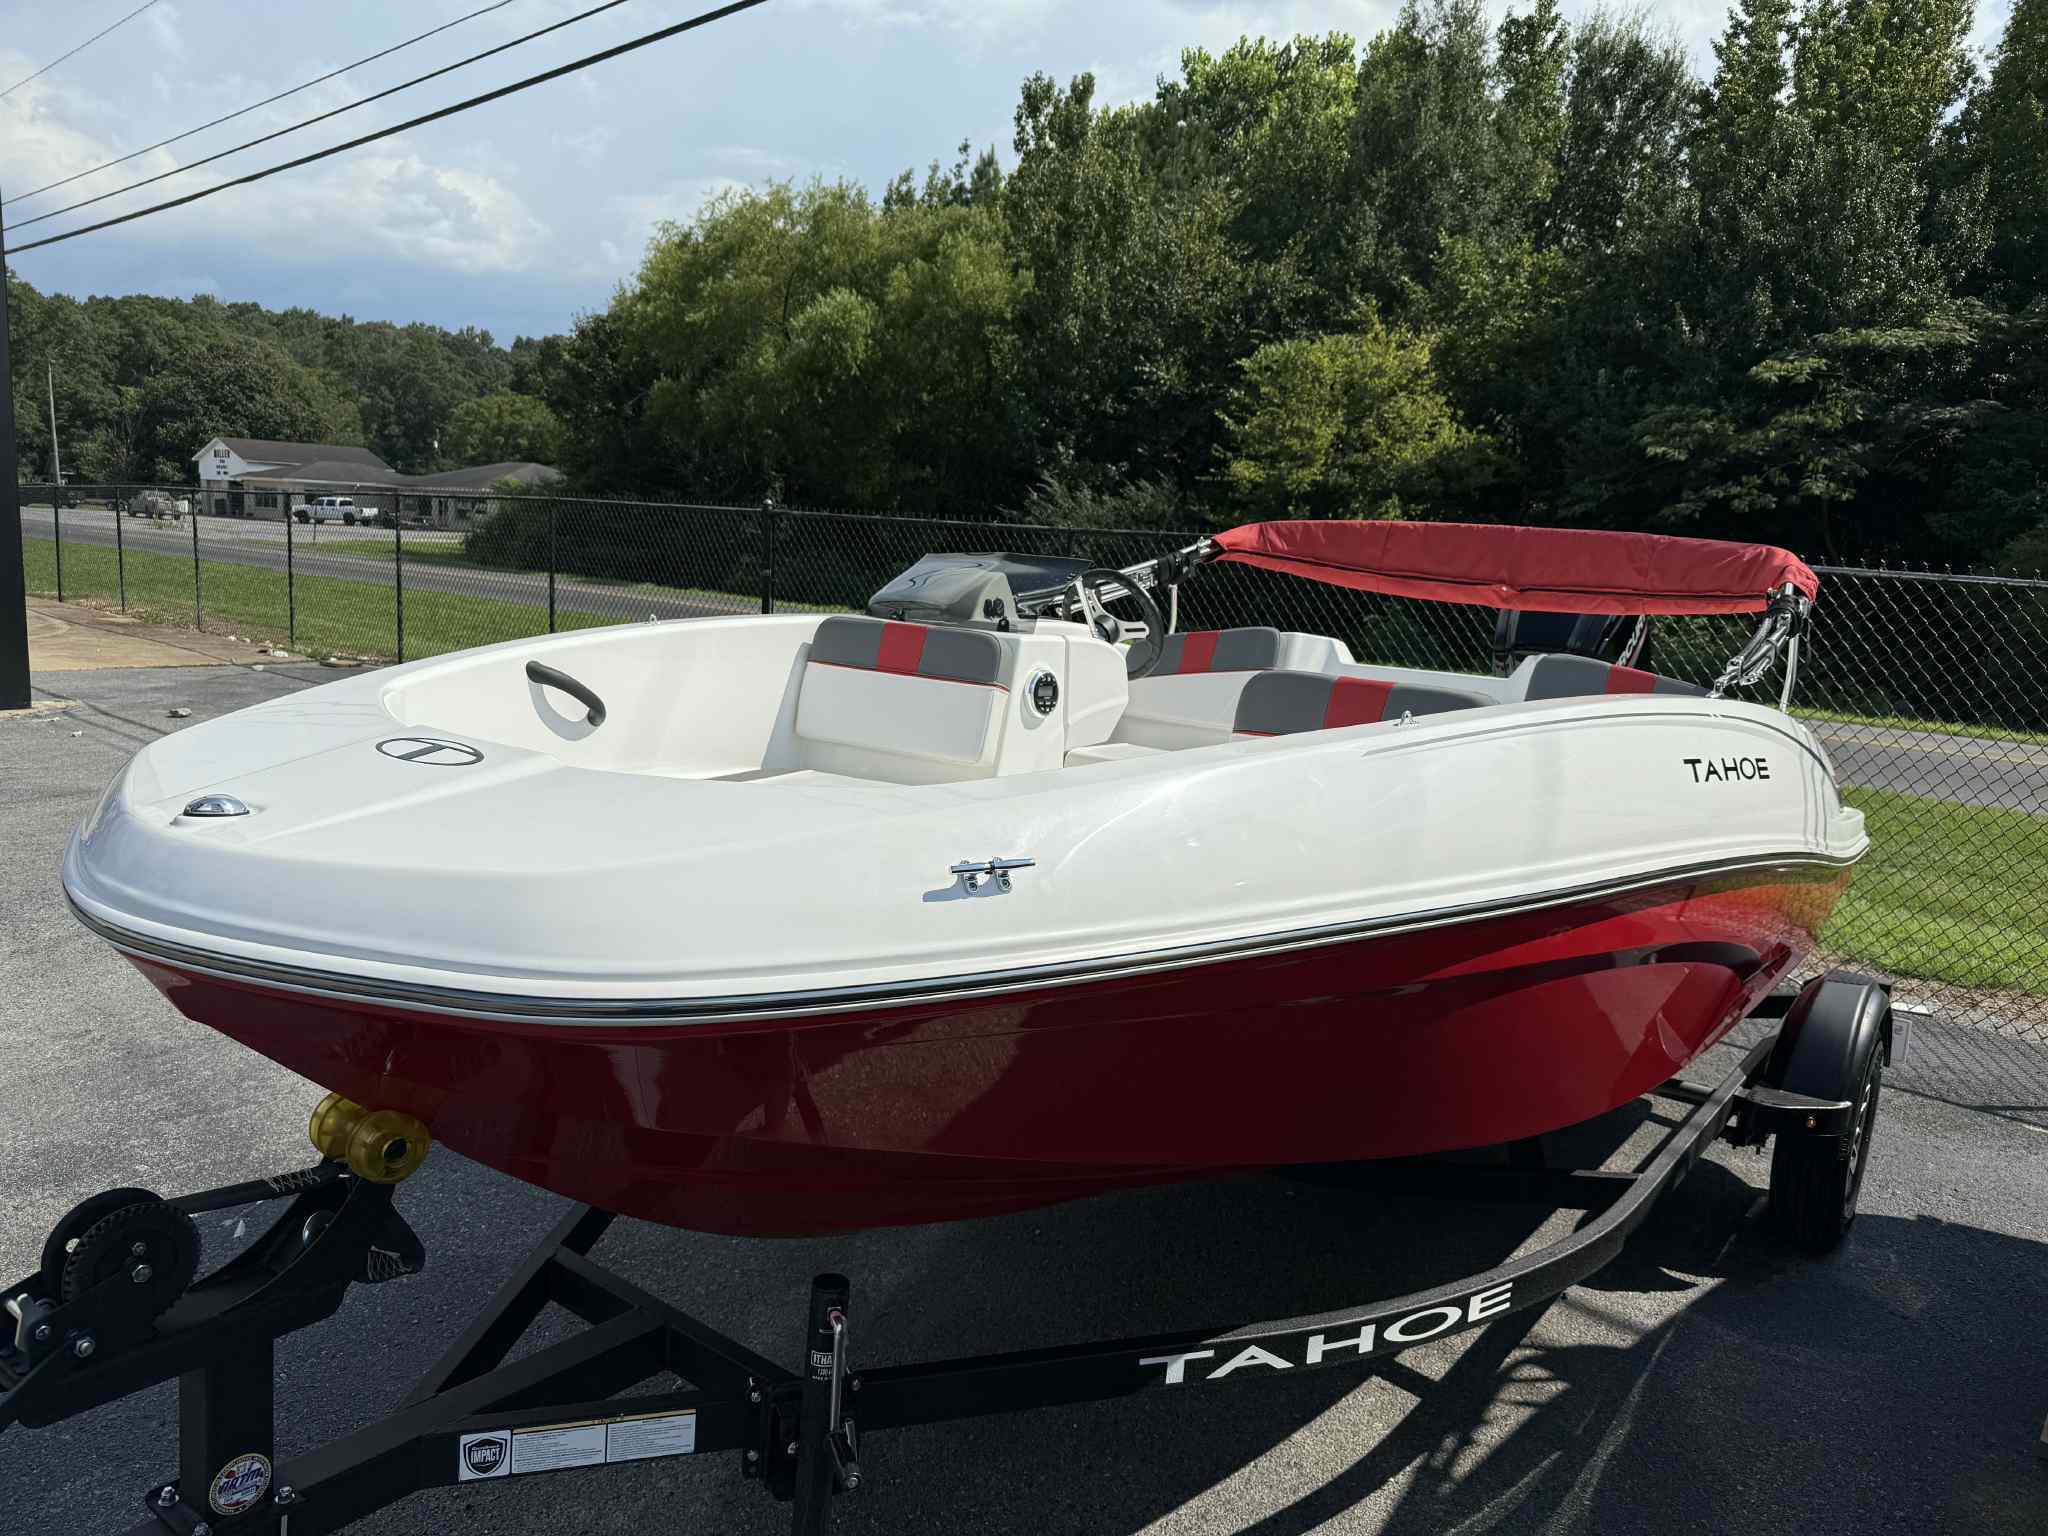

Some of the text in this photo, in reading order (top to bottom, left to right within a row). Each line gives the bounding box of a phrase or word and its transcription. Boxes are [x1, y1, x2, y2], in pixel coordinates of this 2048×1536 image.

[1682, 757, 1770, 783] TAHOE
[1138, 1282, 1513, 1385] TAHOE
[470, 1447, 501, 1464] IMPACT
